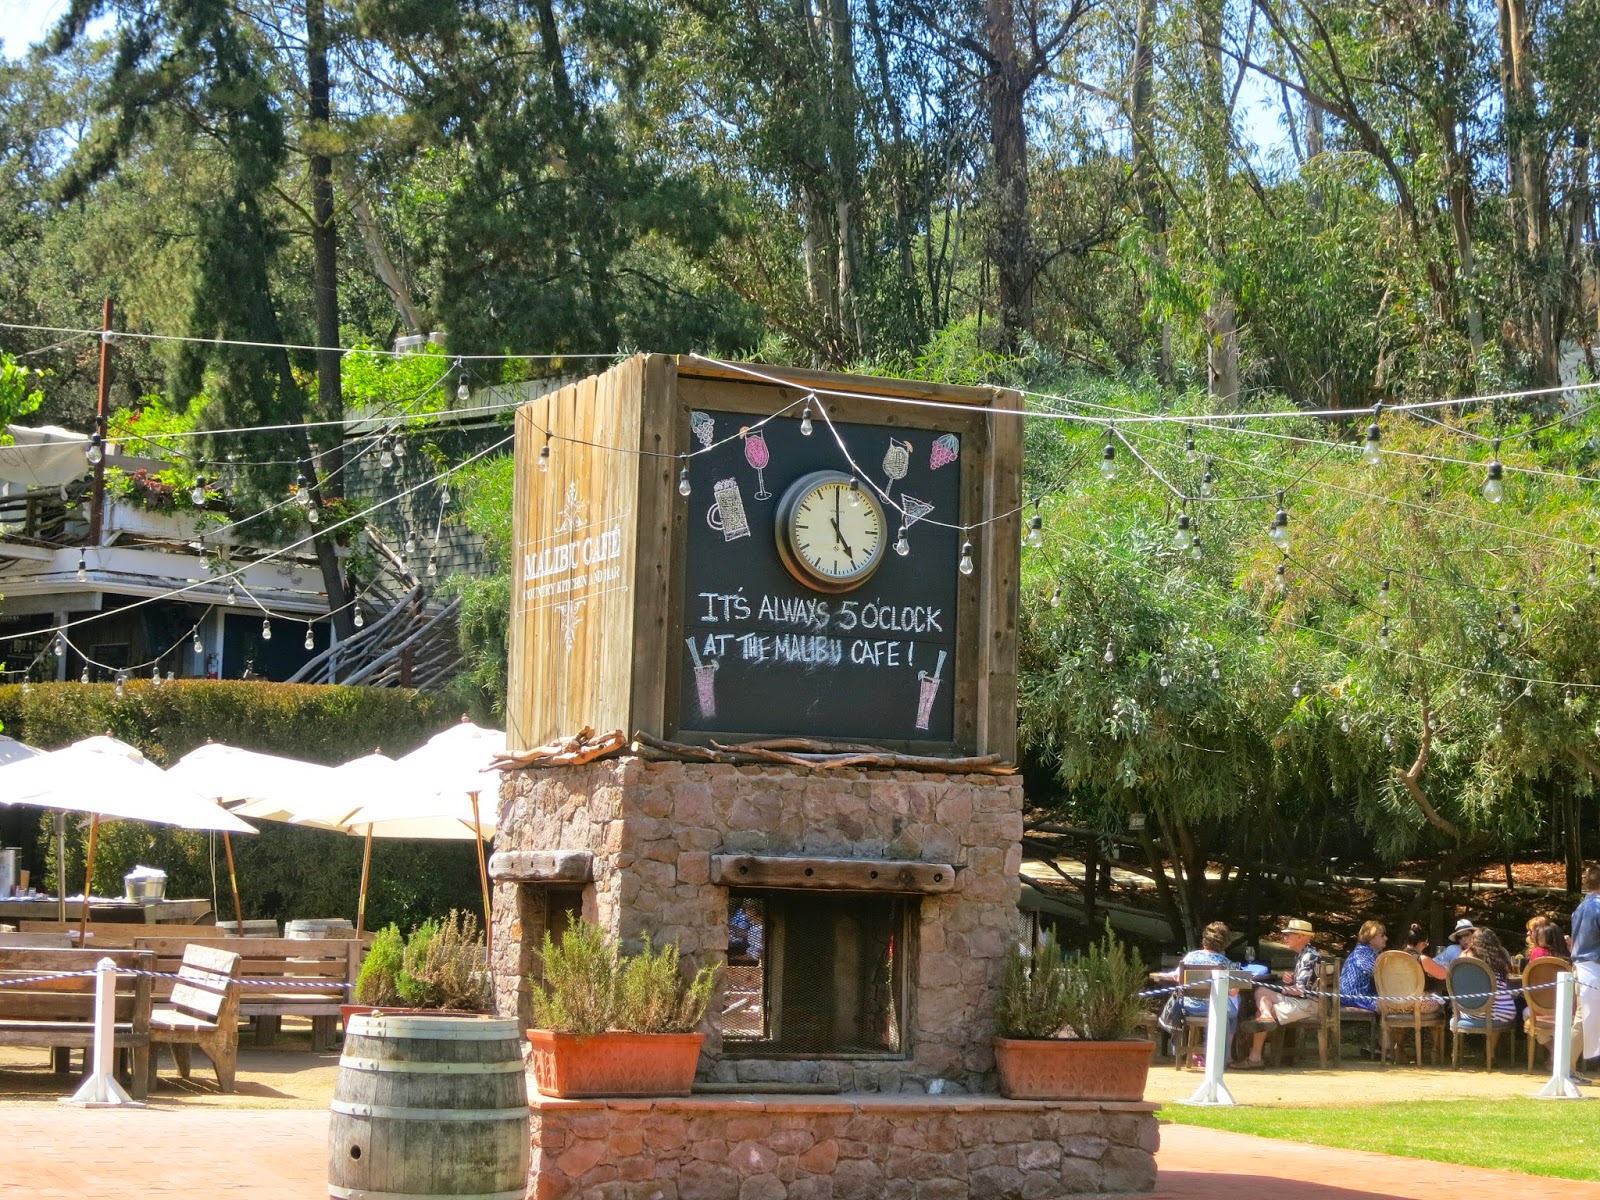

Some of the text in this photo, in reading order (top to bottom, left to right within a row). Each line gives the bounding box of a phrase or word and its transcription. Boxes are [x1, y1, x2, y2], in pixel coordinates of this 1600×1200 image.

[524, 524, 620, 581] MALIBU CAFÉ
[523, 583, 555, 601] COUNTRY
[588, 569, 603, 586] AND
[698, 587, 943, 632] IT'S ALWAYS 5 O'CLOCK
[703, 633, 735, 656] AT
[736, 632, 771, 662] THE
[775, 634, 841, 665] MALIBU
